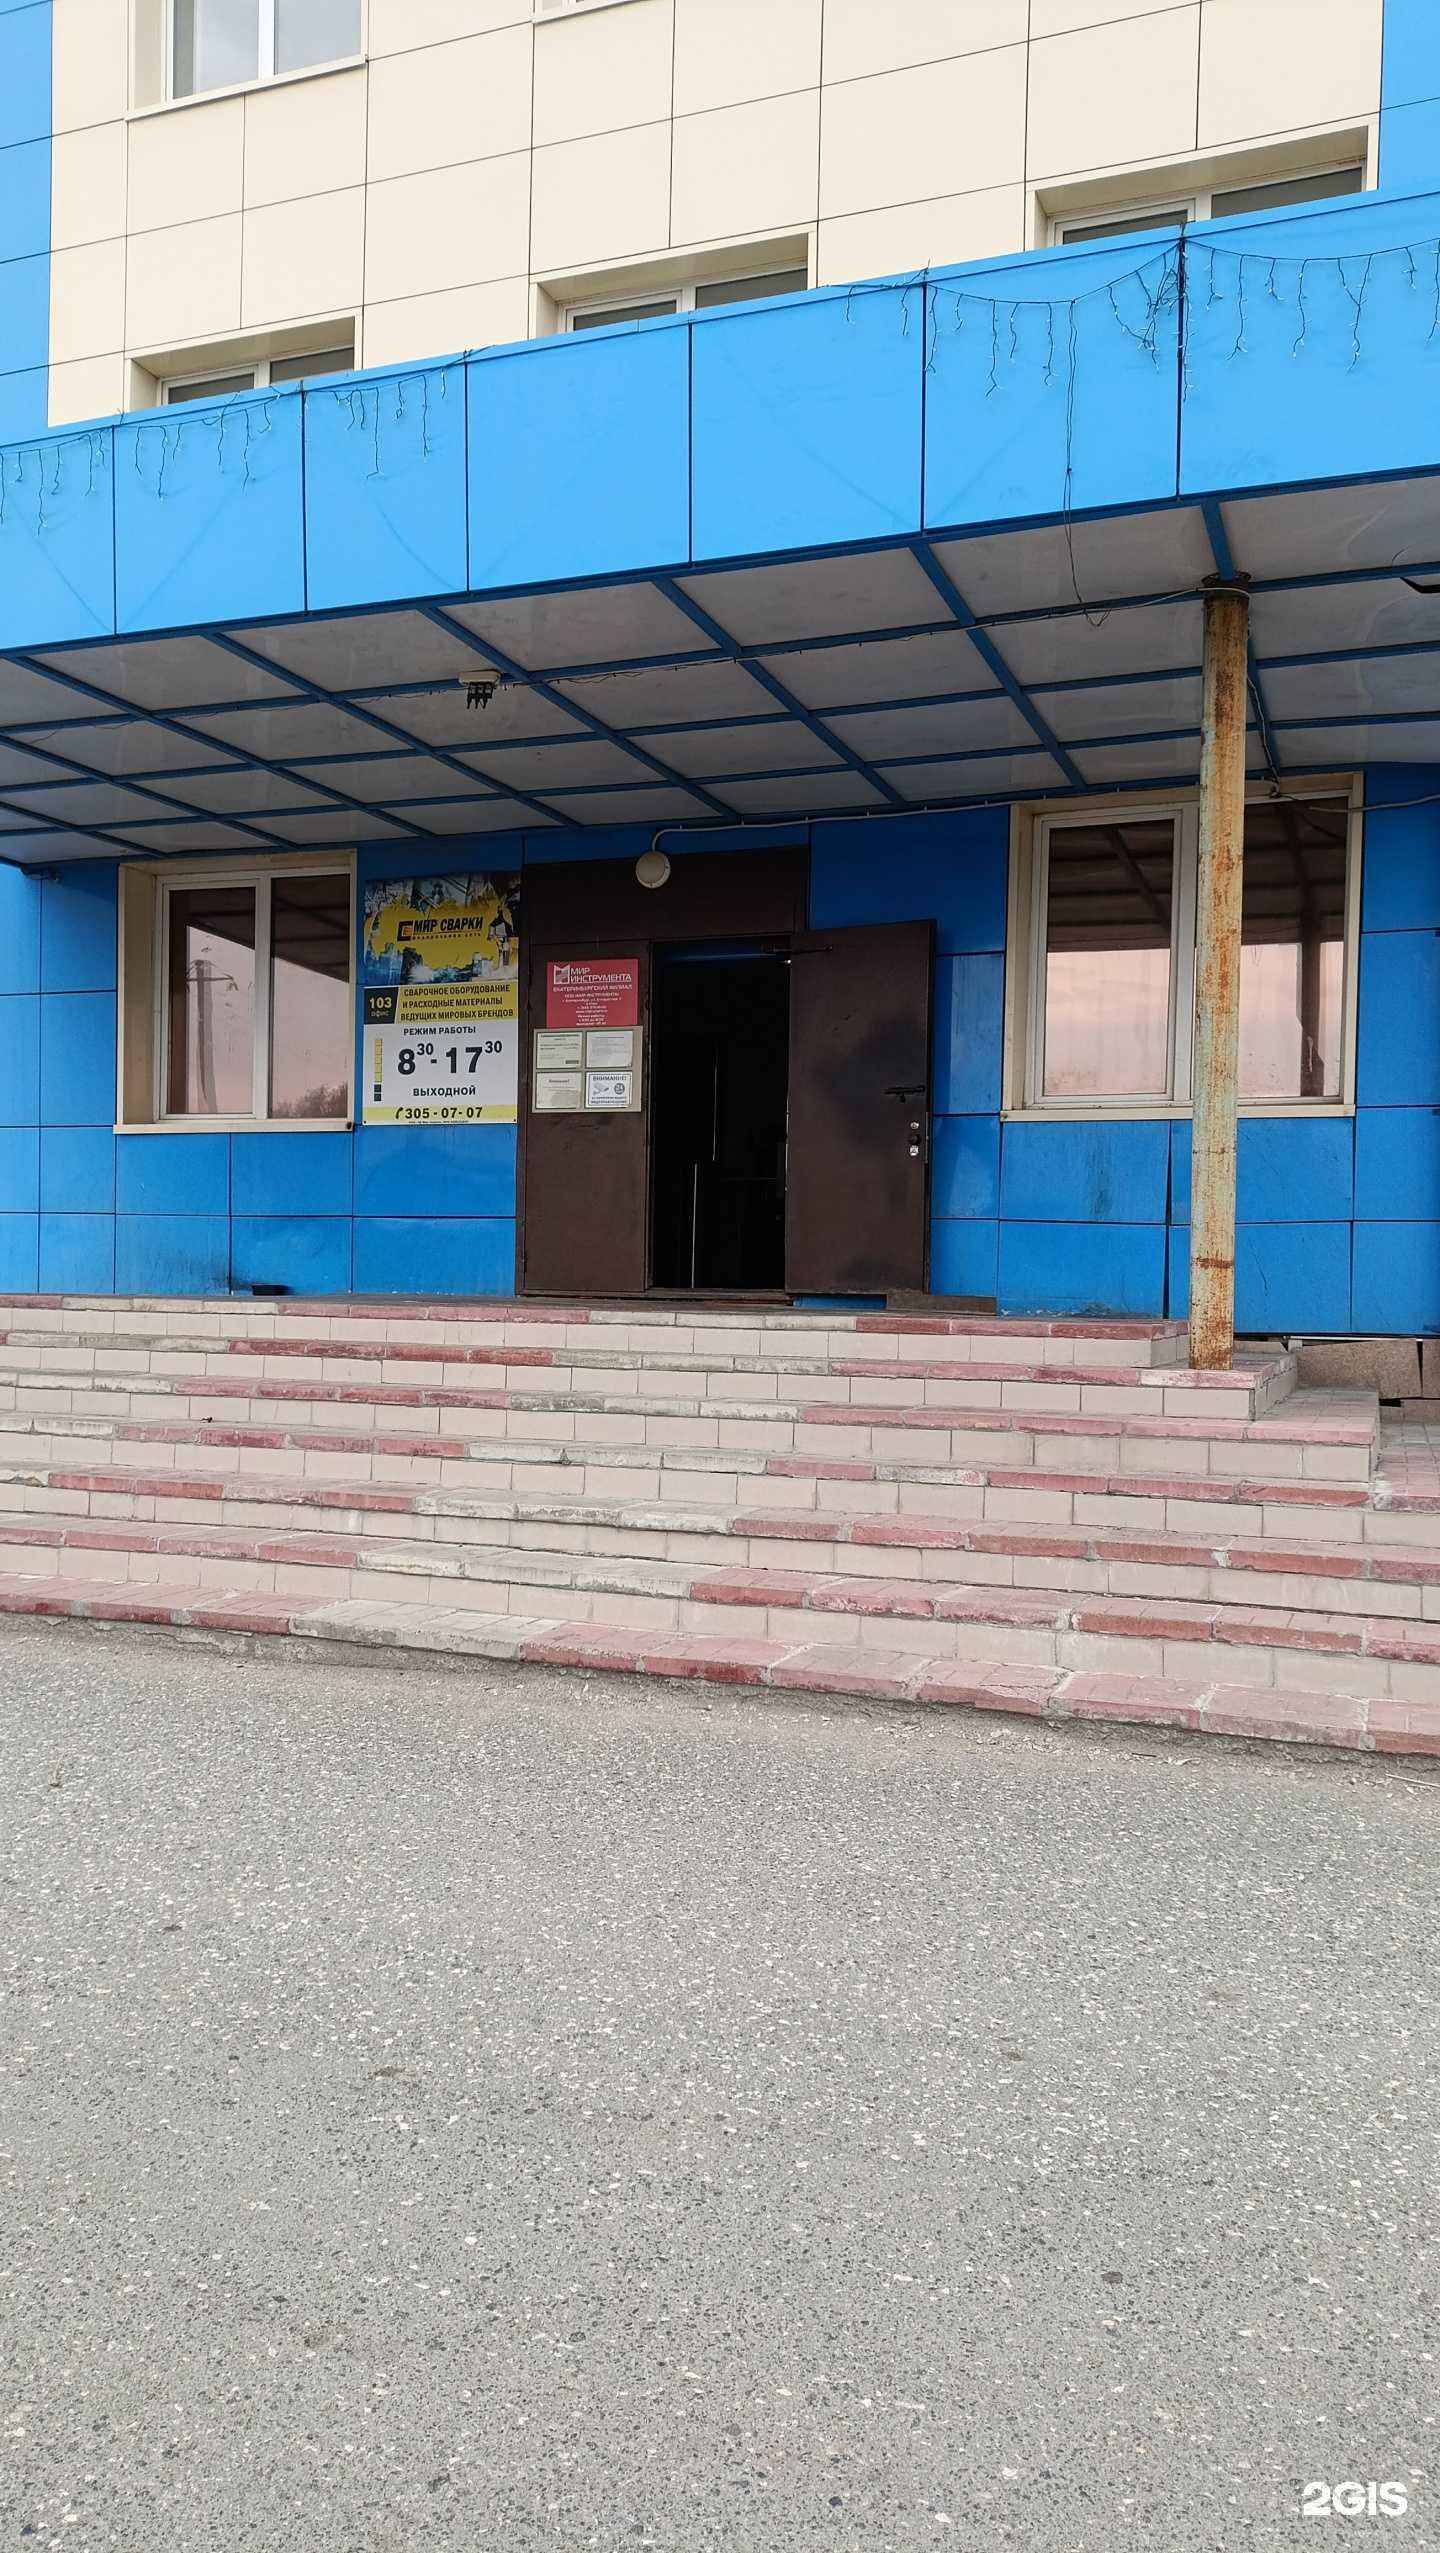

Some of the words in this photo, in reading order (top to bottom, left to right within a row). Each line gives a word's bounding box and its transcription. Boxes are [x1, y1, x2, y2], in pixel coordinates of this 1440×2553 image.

[413, 919, 438, 933] МИР
[440, 917, 483, 931] СВАРКИ
[570, 967, 590, 975] МИР
[570, 973, 632, 983] ИНСТРУМЕНТА
[404, 987, 449, 997] СВАРОЧНОЕ
[450, 984, 510, 995] ОБОРУДОВАНИЕ
[369, 997, 392, 1009] 103
[403, 1001, 408, 1009] И
[409, 999, 455, 1009] РАСХОДНЫЕ
[455, 997, 503, 1007] МАТЕРИАЛЫ
[401, 1012, 437, 1023] ВЕДУЩИХ
[438, 1010, 477, 1020] МИРОВЫХ
[478, 1008, 514, 1019] БРЕНДОВ
[403, 1027, 437, 1036] РЕЖИМ
[438, 1026, 476, 1035] РАБОТЫ
[413, 1085, 476, 1098] ВЫХОДНОЙ
